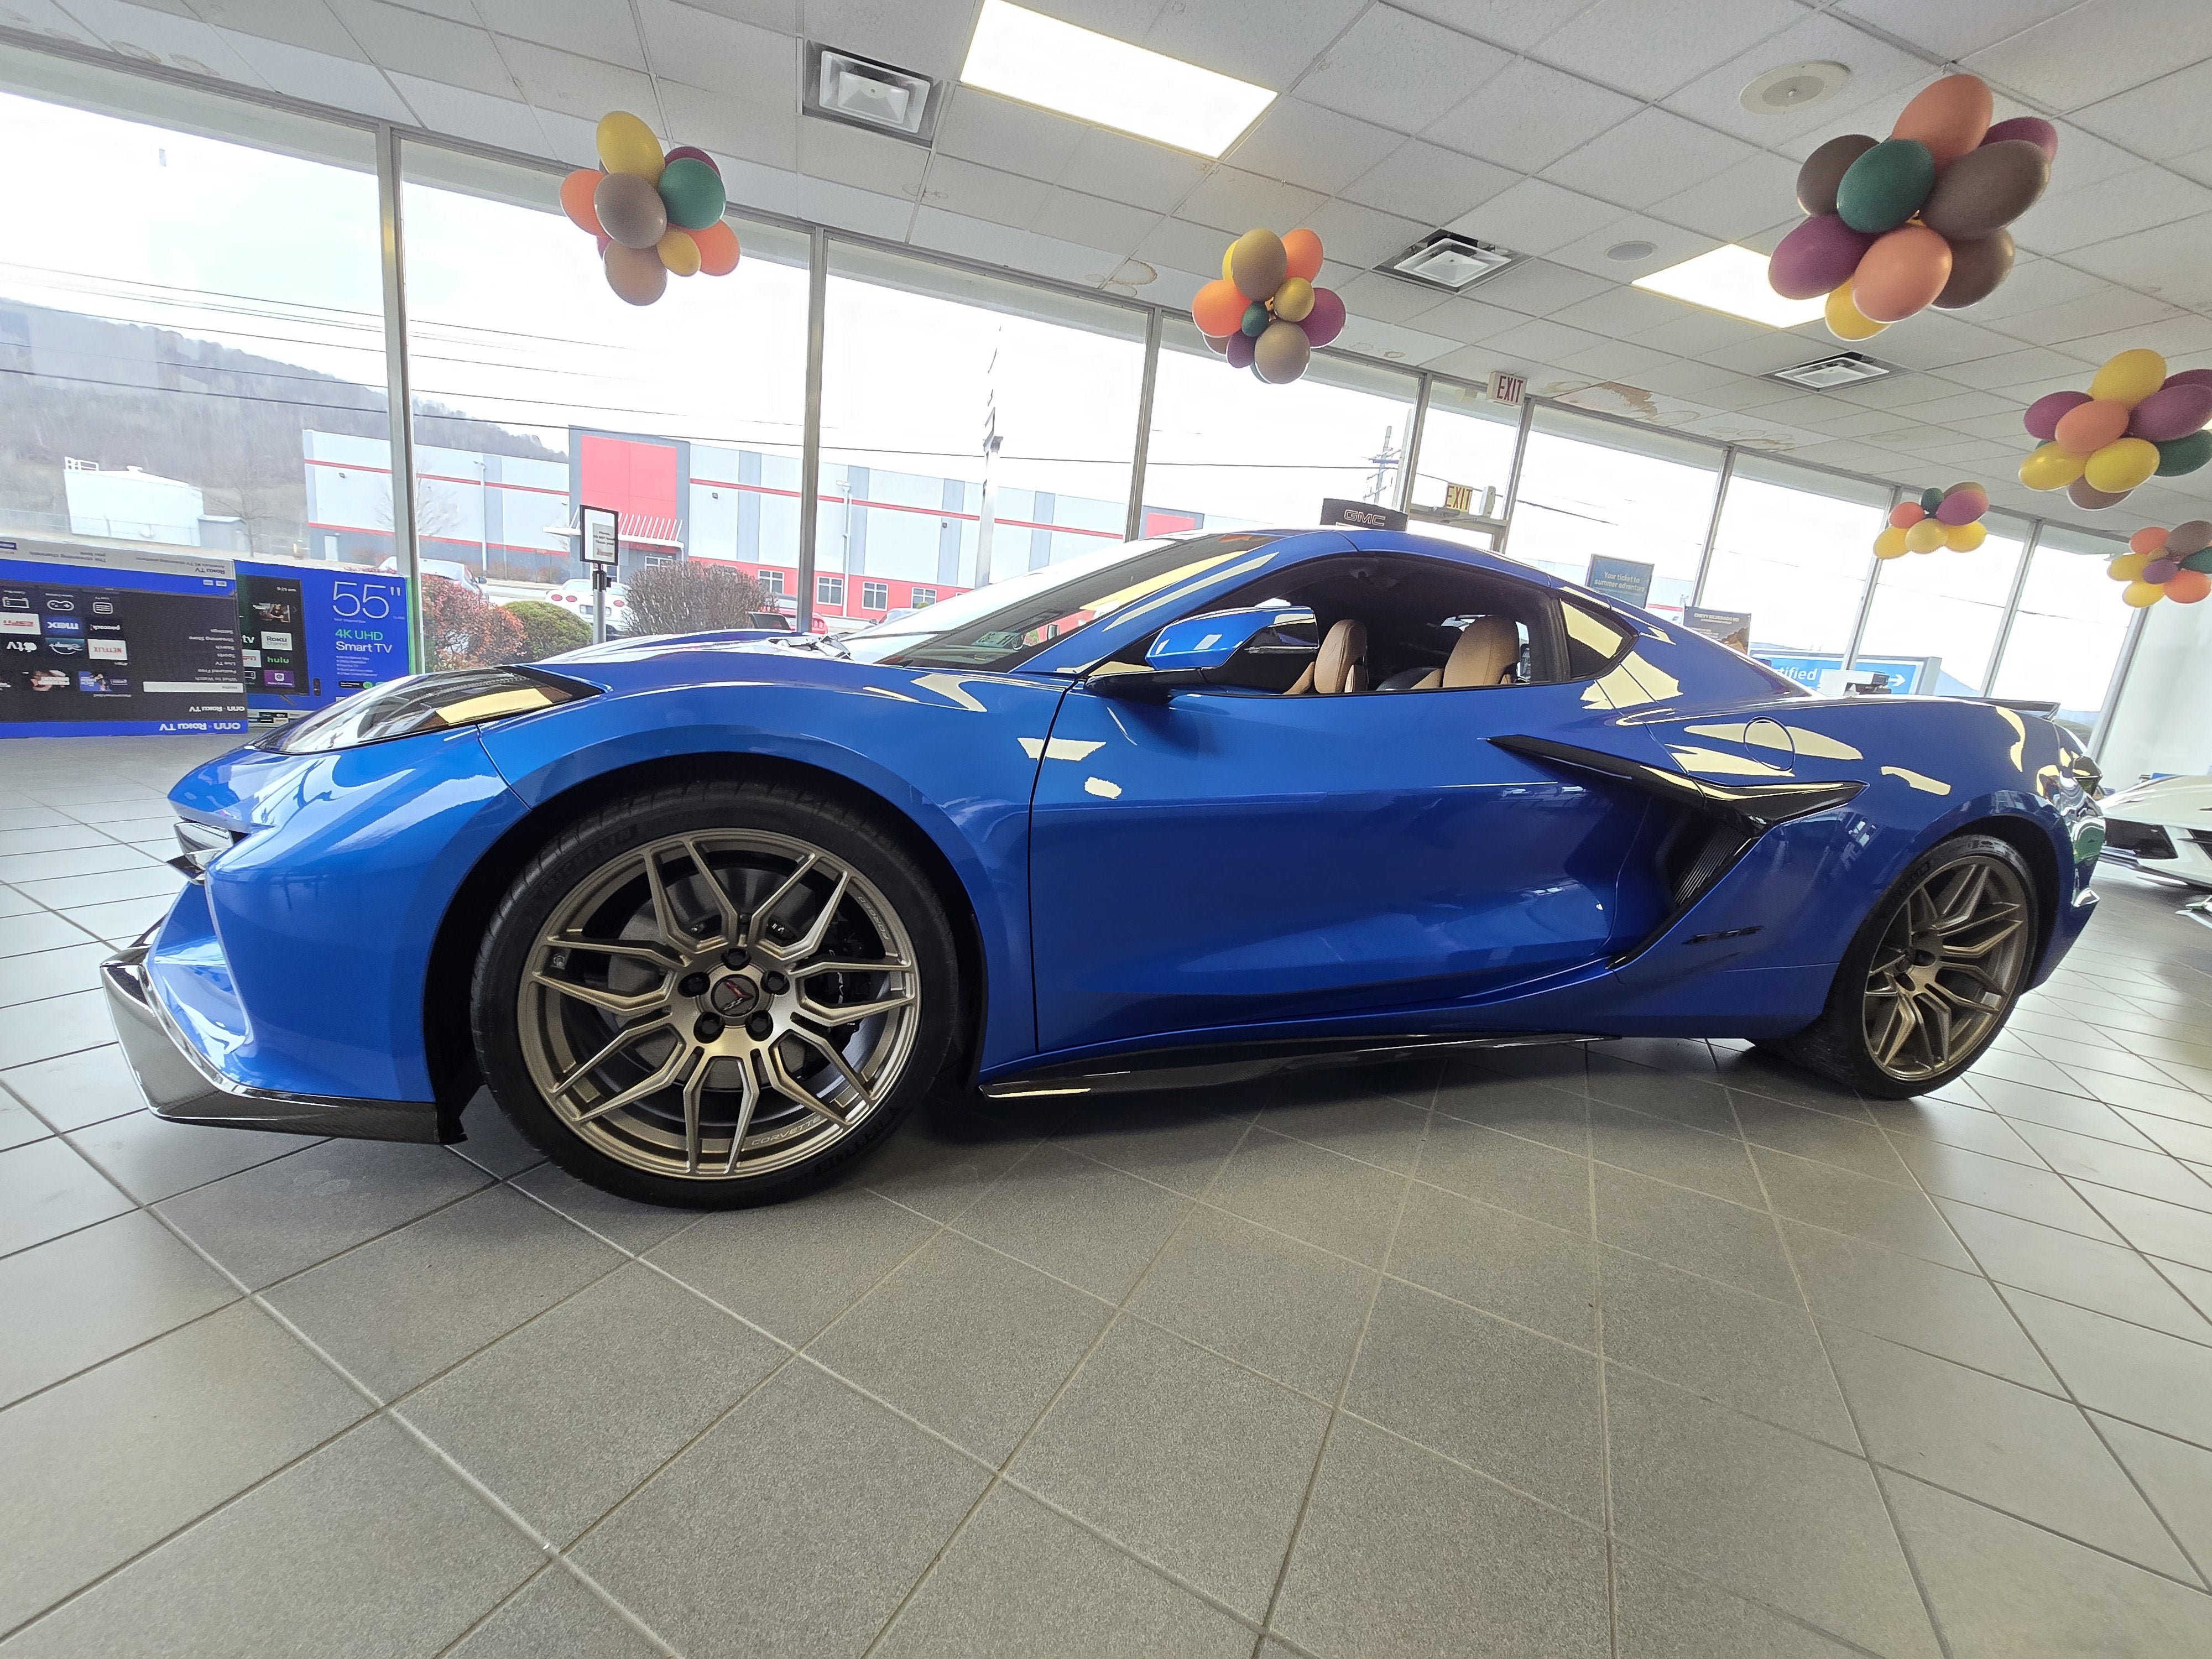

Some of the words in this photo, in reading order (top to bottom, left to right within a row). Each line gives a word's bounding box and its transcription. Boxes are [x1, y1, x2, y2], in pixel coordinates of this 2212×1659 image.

[1496, 375, 1523, 403] EXIT
[1446, 485, 1472, 510] EXIT
[1344, 509, 1386, 526] GMC
[1594, 579, 1618, 587] summer
[1604, 571, 1616, 580] Your
[1617, 574, 1633, 582] ticket
[332, 581, 401, 619] 55"
[46, 622, 79, 630] max
[335, 629, 352, 639] 4K
[354, 630, 383, 640] UHD
[6, 641, 24, 651] tv
[336, 641, 372, 652] Smart
[373, 643, 393, 654] TV
[1777, 666, 1818, 681] tified
[752, 1115, 821, 1145] CORVETTE
